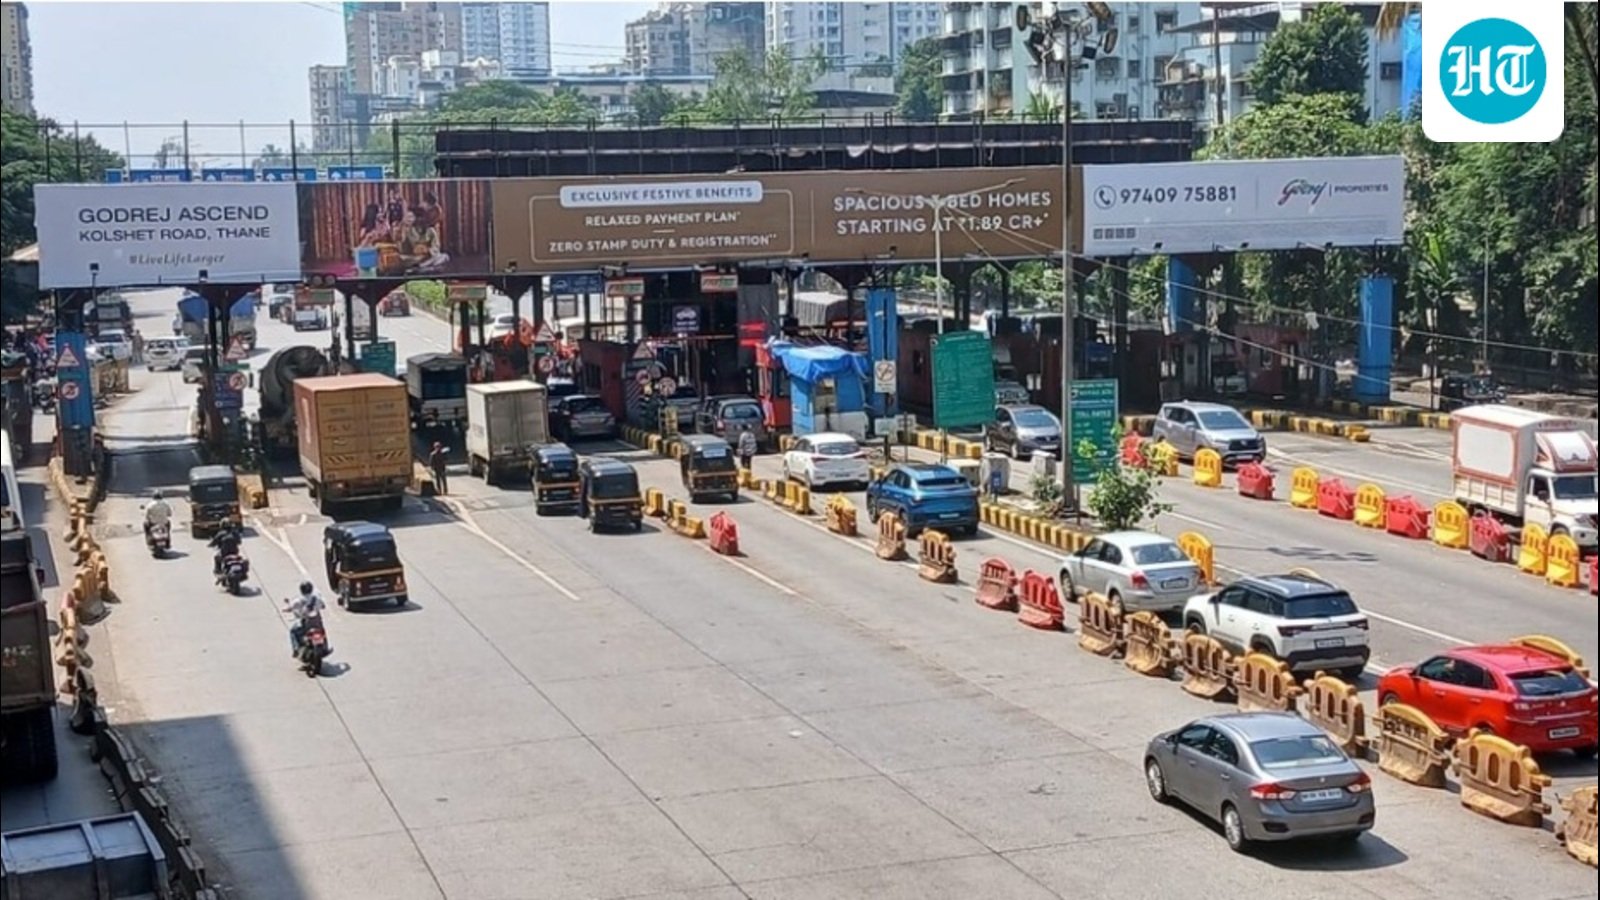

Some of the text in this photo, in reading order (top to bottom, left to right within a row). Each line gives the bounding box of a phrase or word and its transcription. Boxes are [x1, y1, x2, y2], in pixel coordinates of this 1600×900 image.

[571, 186, 754, 203] EXCLUSIVE FESTIVE BENEFITS
[1120, 185, 1238, 204] 97409 75881
[1334, 184, 1389, 194] PROPERTIES
[833, 195, 925, 212] SPACIOUS
[947, 193, 982, 209] BED
[988, 191, 1052, 207] HOMES
[78, 205, 269, 224] GODREJ ASCEND
[584, 214, 641, 227] RELAXED
[645, 212, 701, 225] PAYMENT
[79, 226, 270, 242] KOLSHET ROAD, THANE
[836, 217, 927, 235] STARTING
[931, 217, 954, 232] AT
[549, 240, 584, 253] ZERO
[587, 238, 628, 251] STAMP
[632, 237, 665, 250] DUTY
[668, 236, 677, 249] &
[128, 253, 226, 266] #LiveLifeLarger
